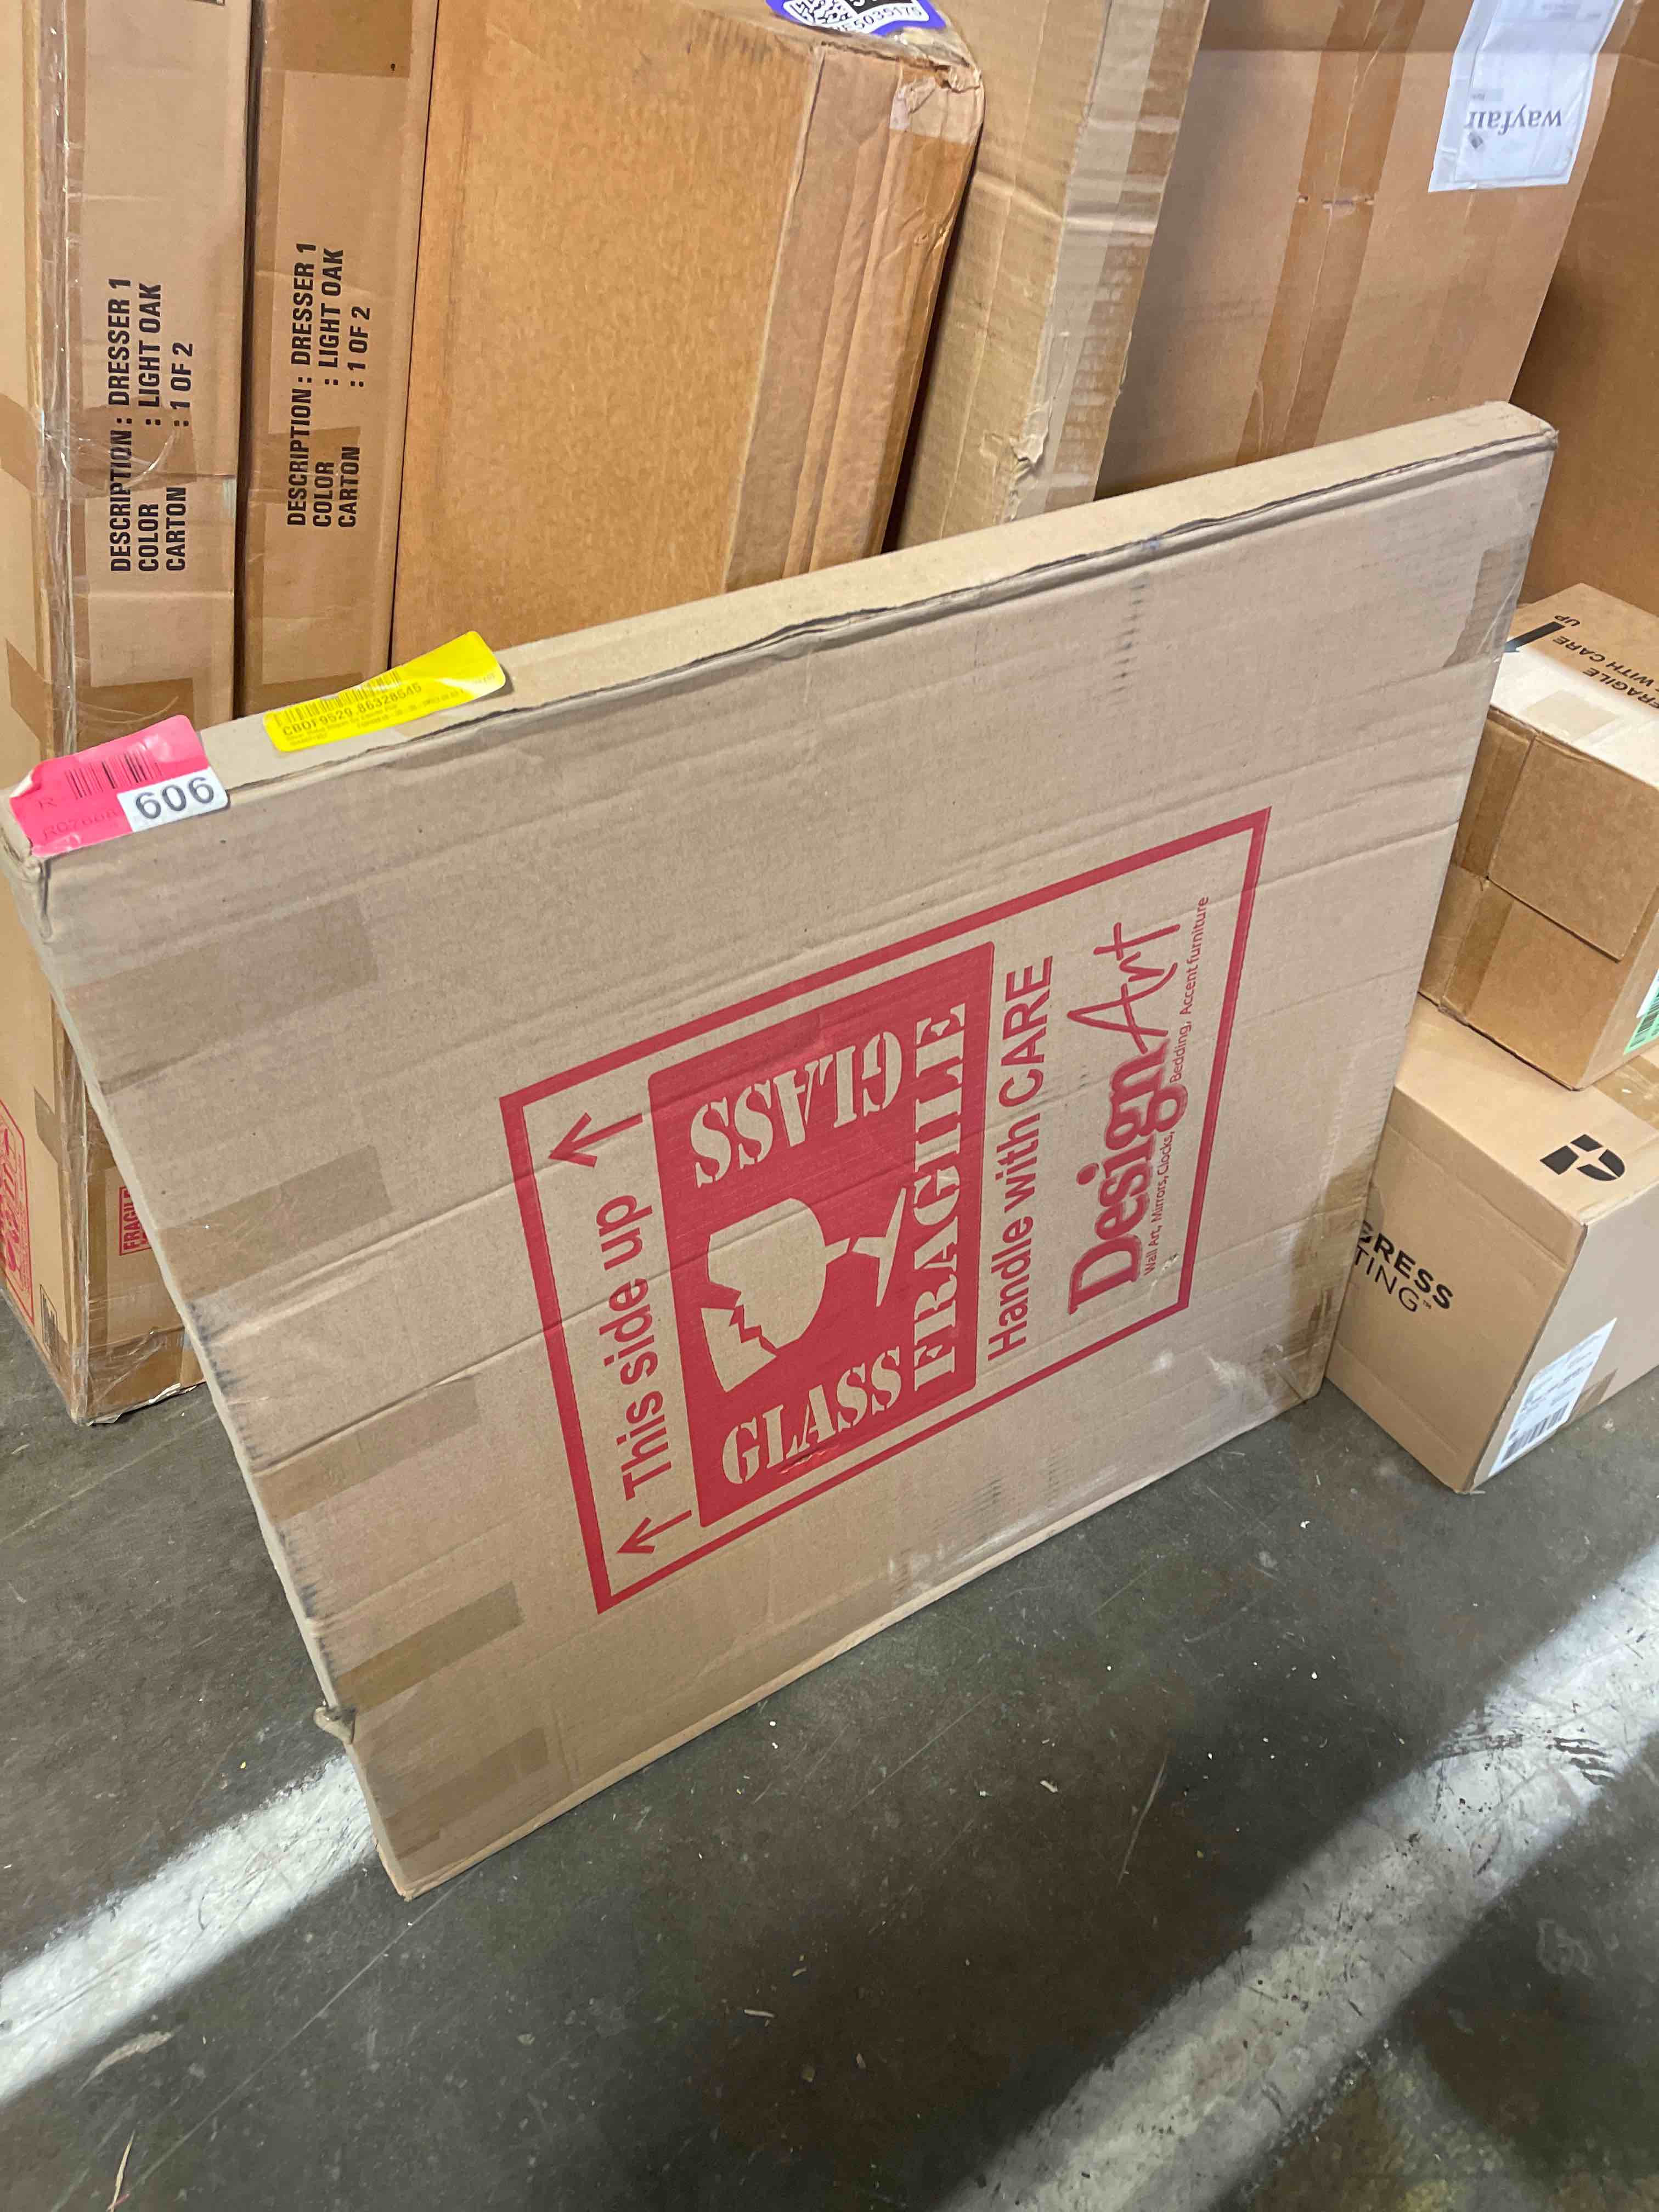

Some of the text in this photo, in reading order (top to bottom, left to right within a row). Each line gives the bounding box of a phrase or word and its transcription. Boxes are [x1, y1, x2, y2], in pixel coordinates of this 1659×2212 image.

[1464, 103, 1562, 136] wayfair
[296, 242, 317, 252] 1
[321, 248, 344, 297] OAK
[108, 279, 131, 290] 1
[139, 283, 161, 333] OAK
[291, 261, 315, 365] DRESSER
[318, 302, 341, 368] LIGHT
[352, 306, 370, 320] 2
[108, 300, 130, 405] DRESSER
[173, 342, 193, 357] 2
[348, 326, 369, 354] OF
[138, 340, 161, 407] LIGHT
[171, 362, 191, 391] OF
[347, 362, 366, 371] 1
[170, 400, 191, 409] 1
[287, 388, 312, 526] DESCRIPTION
[110, 430, 132, 571] DESCRIPTION
[313, 462, 334, 527] COLOR
[338, 447, 360, 528] CARTON
[138, 504, 159, 571] COLOR
[166, 487, 187, 571] CARTON
[1554, 614, 1581, 627] UP
[1553, 636, 1654, 687] WITH CARE
[136, 776, 215, 820] 606
[1187, 896, 1209, 964] furniture
[1180, 964, 1198, 1014] Accent
[1170, 1021, 1192, 1083] Bedding,
[690, 1032, 904, 1188] GLASS
[989, 956, 1053, 1360] Handle with CARE
[1157, 1131, 1175, 1176] Clocks,
[913, 1004, 966, 1392] FRAGILE
[1151, 1176, 1169, 1222] Mirrors,
[1144, 1249, 1158, 1276] Wall
[596, 1194, 670, 1499] This side up
[722, 1346, 902, 1485] GLASS
